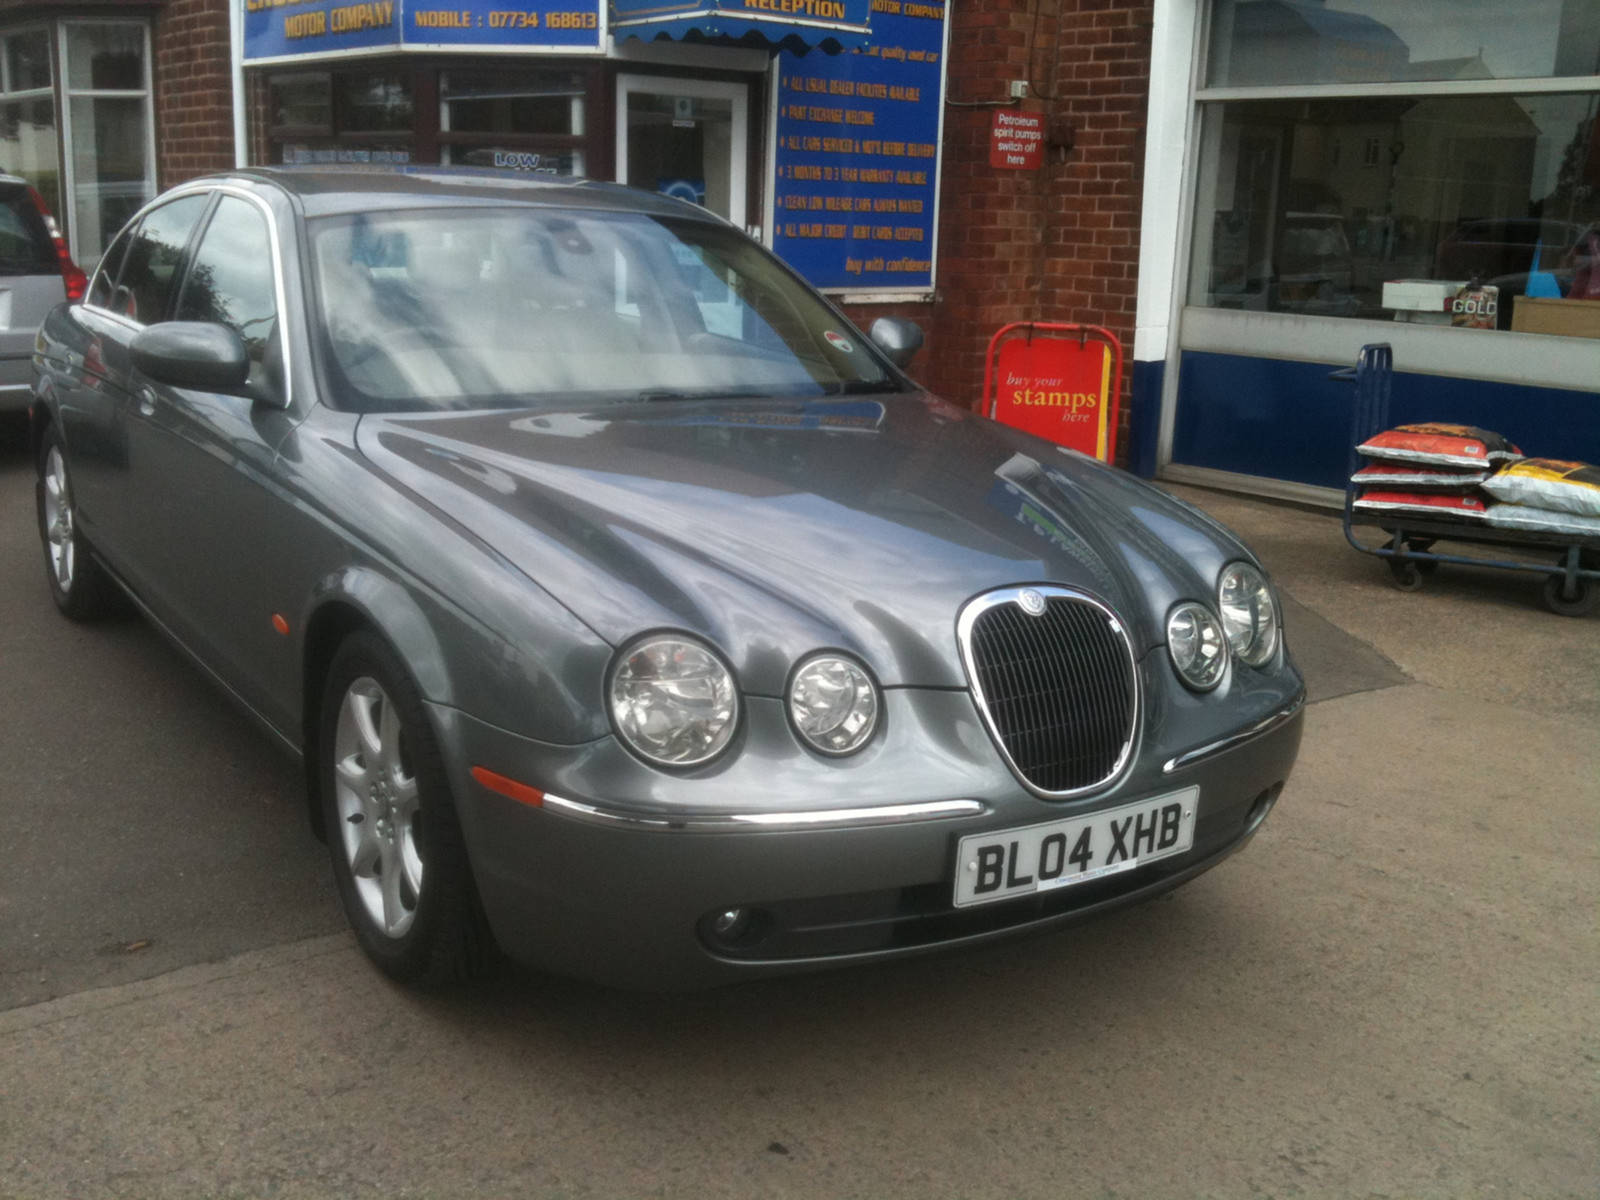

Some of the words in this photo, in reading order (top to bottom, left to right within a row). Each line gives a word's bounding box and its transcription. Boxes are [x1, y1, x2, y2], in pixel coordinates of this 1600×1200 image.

[745, 0, 845, 19] RECEPTION
[904, 3, 945, 19] COMPANY
[284, 11, 326, 38] MOTOR
[331, 2, 393, 31] COMPANY
[415, 11, 471, 27] MOBILE
[489, 11, 539, 28] 07734
[545, 12, 597, 28] 168613
[791, 77, 803, 92] ALL
[789, 105, 806, 119] PART
[809, 107, 843, 123] EXCHANGE
[845, 110, 874, 125] WELCOME
[998, 113, 1039, 127] Petroleum
[994, 128, 1014, 139] spirit
[1015, 130, 1041, 141] pumps
[789, 136, 800, 150] ALL
[998, 141, 1023, 152] switch
[1024, 142, 1037, 152] off
[495, 152, 540, 168] LOW
[1007, 153, 1025, 165] here
[785, 223, 797, 237] ALL
[865, 257, 884, 272] with
[1452, 299, 1497, 315] GOLD
[1006, 371, 1029, 390] buy
[1032, 377, 1063, 391] your
[1012, 388, 1097, 413] stamps
[1062, 409, 1090, 422] here
[974, 826, 1093, 895] BL04
[1106, 802, 1182, 866] XHB
